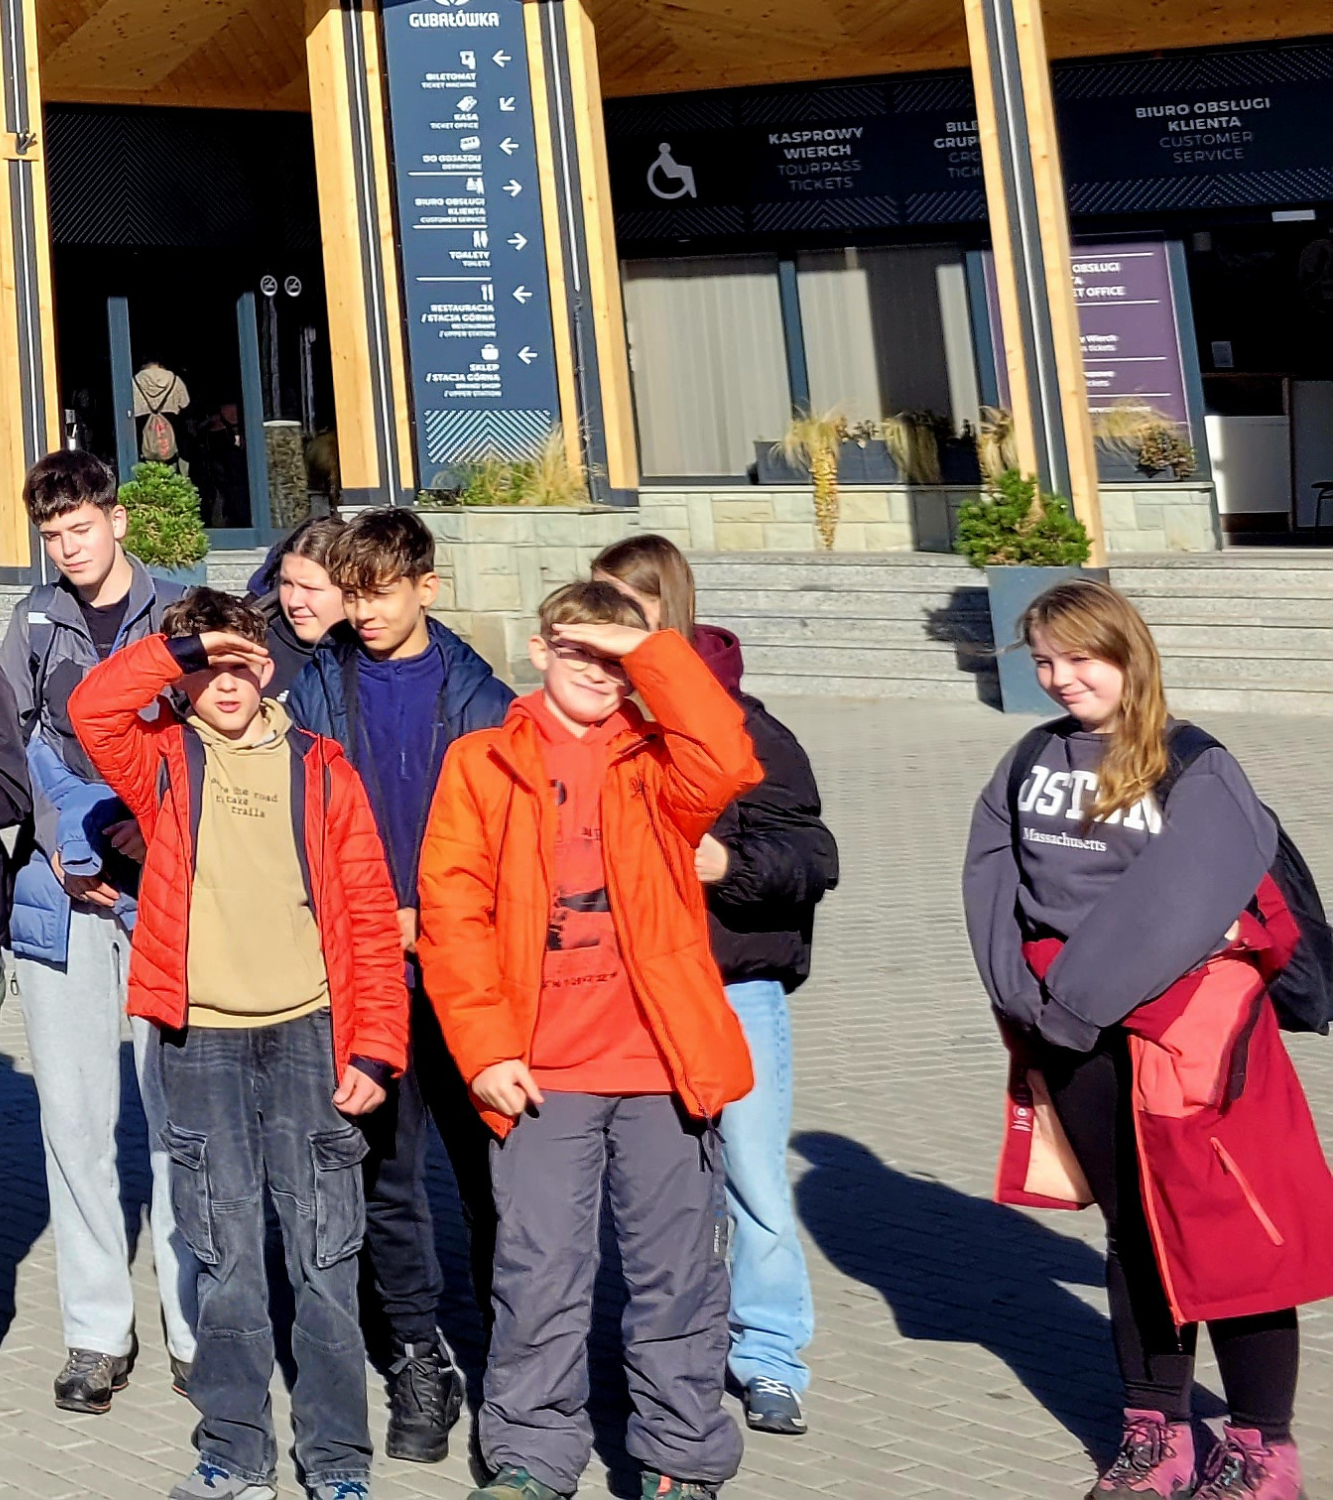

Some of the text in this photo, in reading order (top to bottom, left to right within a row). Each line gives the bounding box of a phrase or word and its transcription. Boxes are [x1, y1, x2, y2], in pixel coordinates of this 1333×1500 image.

[409, 10, 500, 28] GUBAŁÓWKA
[1135, 97, 1271, 119] BIURO OBSŁUGI
[1168, 116, 1242, 132] KLIENTA
[768, 127, 864, 145] KASPROWY
[1159, 131, 1254, 148] CUSTOMER
[783, 144, 852, 160] WIERCH
[1173, 148, 1246, 164] SERVICE
[777, 159, 863, 176] TOURPASS
[788, 176, 854, 191] TICKETS
[1086, 286, 1126, 297] OFFICE
[1023, 827, 1107, 852] Massachusetts
